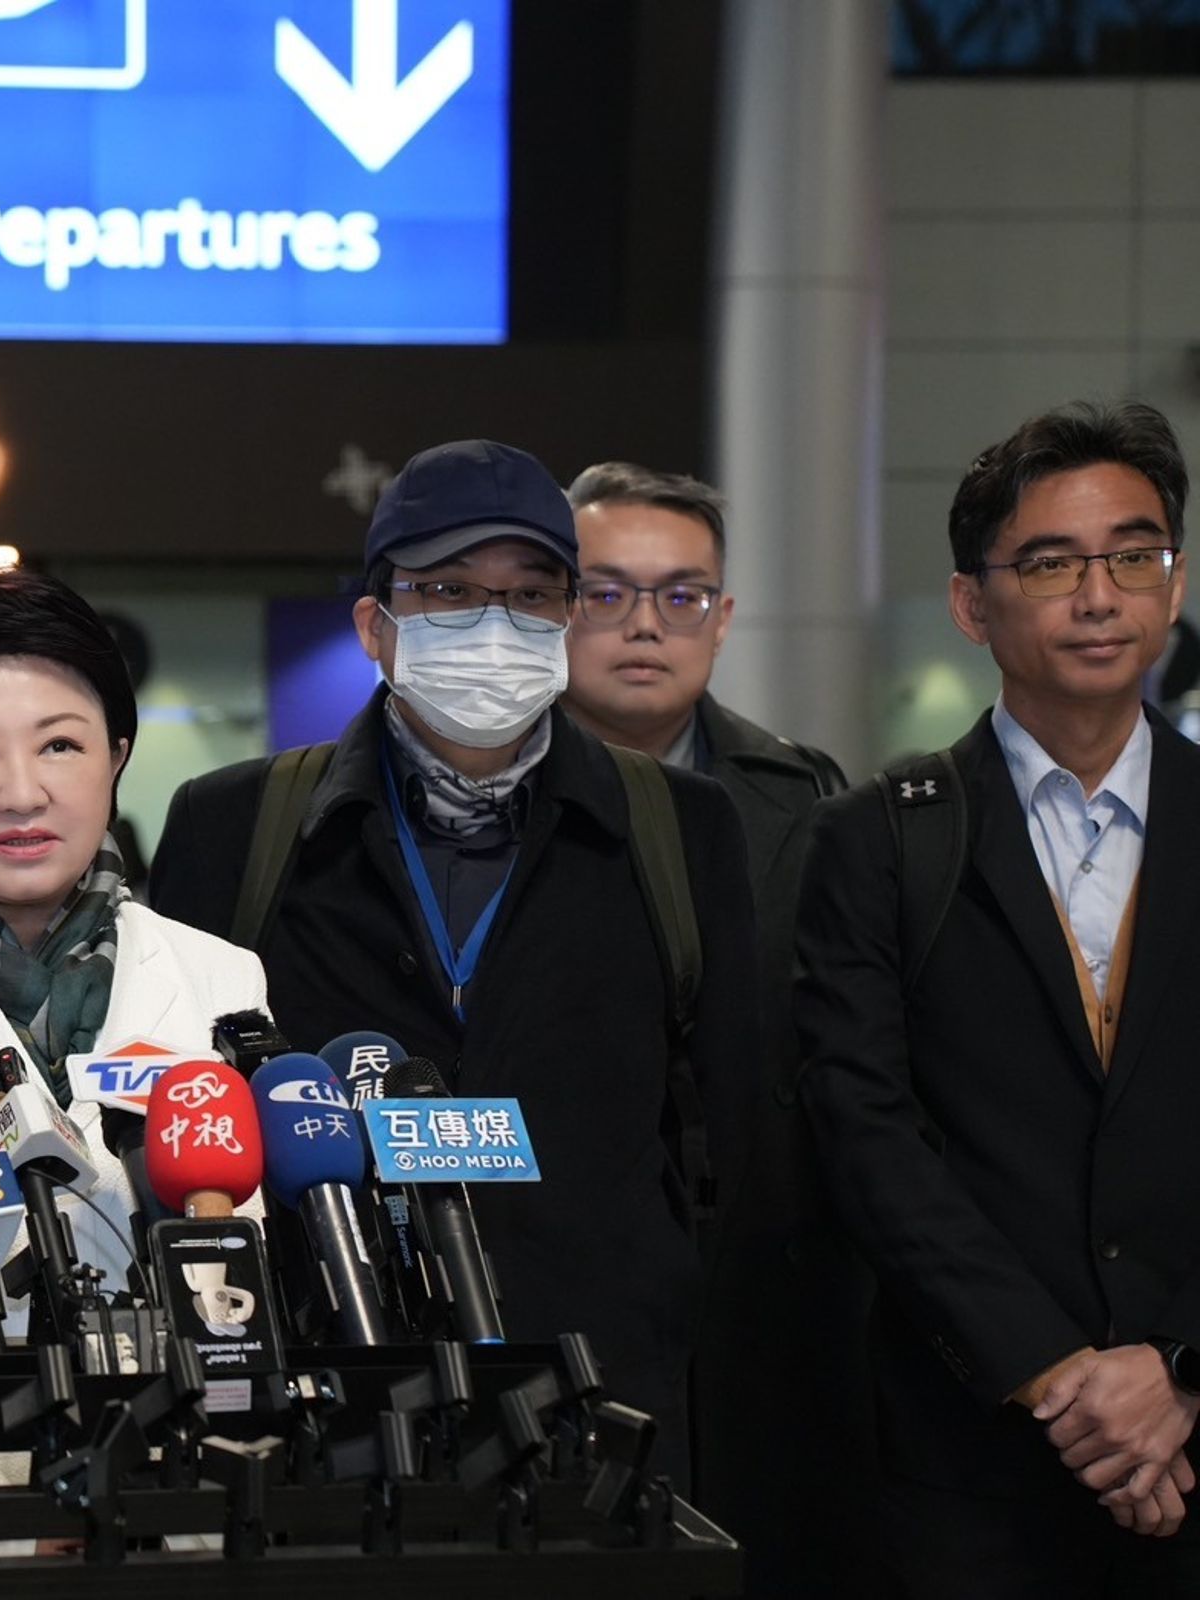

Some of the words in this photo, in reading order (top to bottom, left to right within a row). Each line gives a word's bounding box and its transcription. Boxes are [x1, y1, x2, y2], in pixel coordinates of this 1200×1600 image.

[160, 1112, 244, 1159] 中視
[294, 1113, 351, 1140] 中天
[379, 1108, 520, 1148] 互傳媒
[419, 1155, 460, 1168] HOO
[465, 1155, 527, 1168] MEDIA
